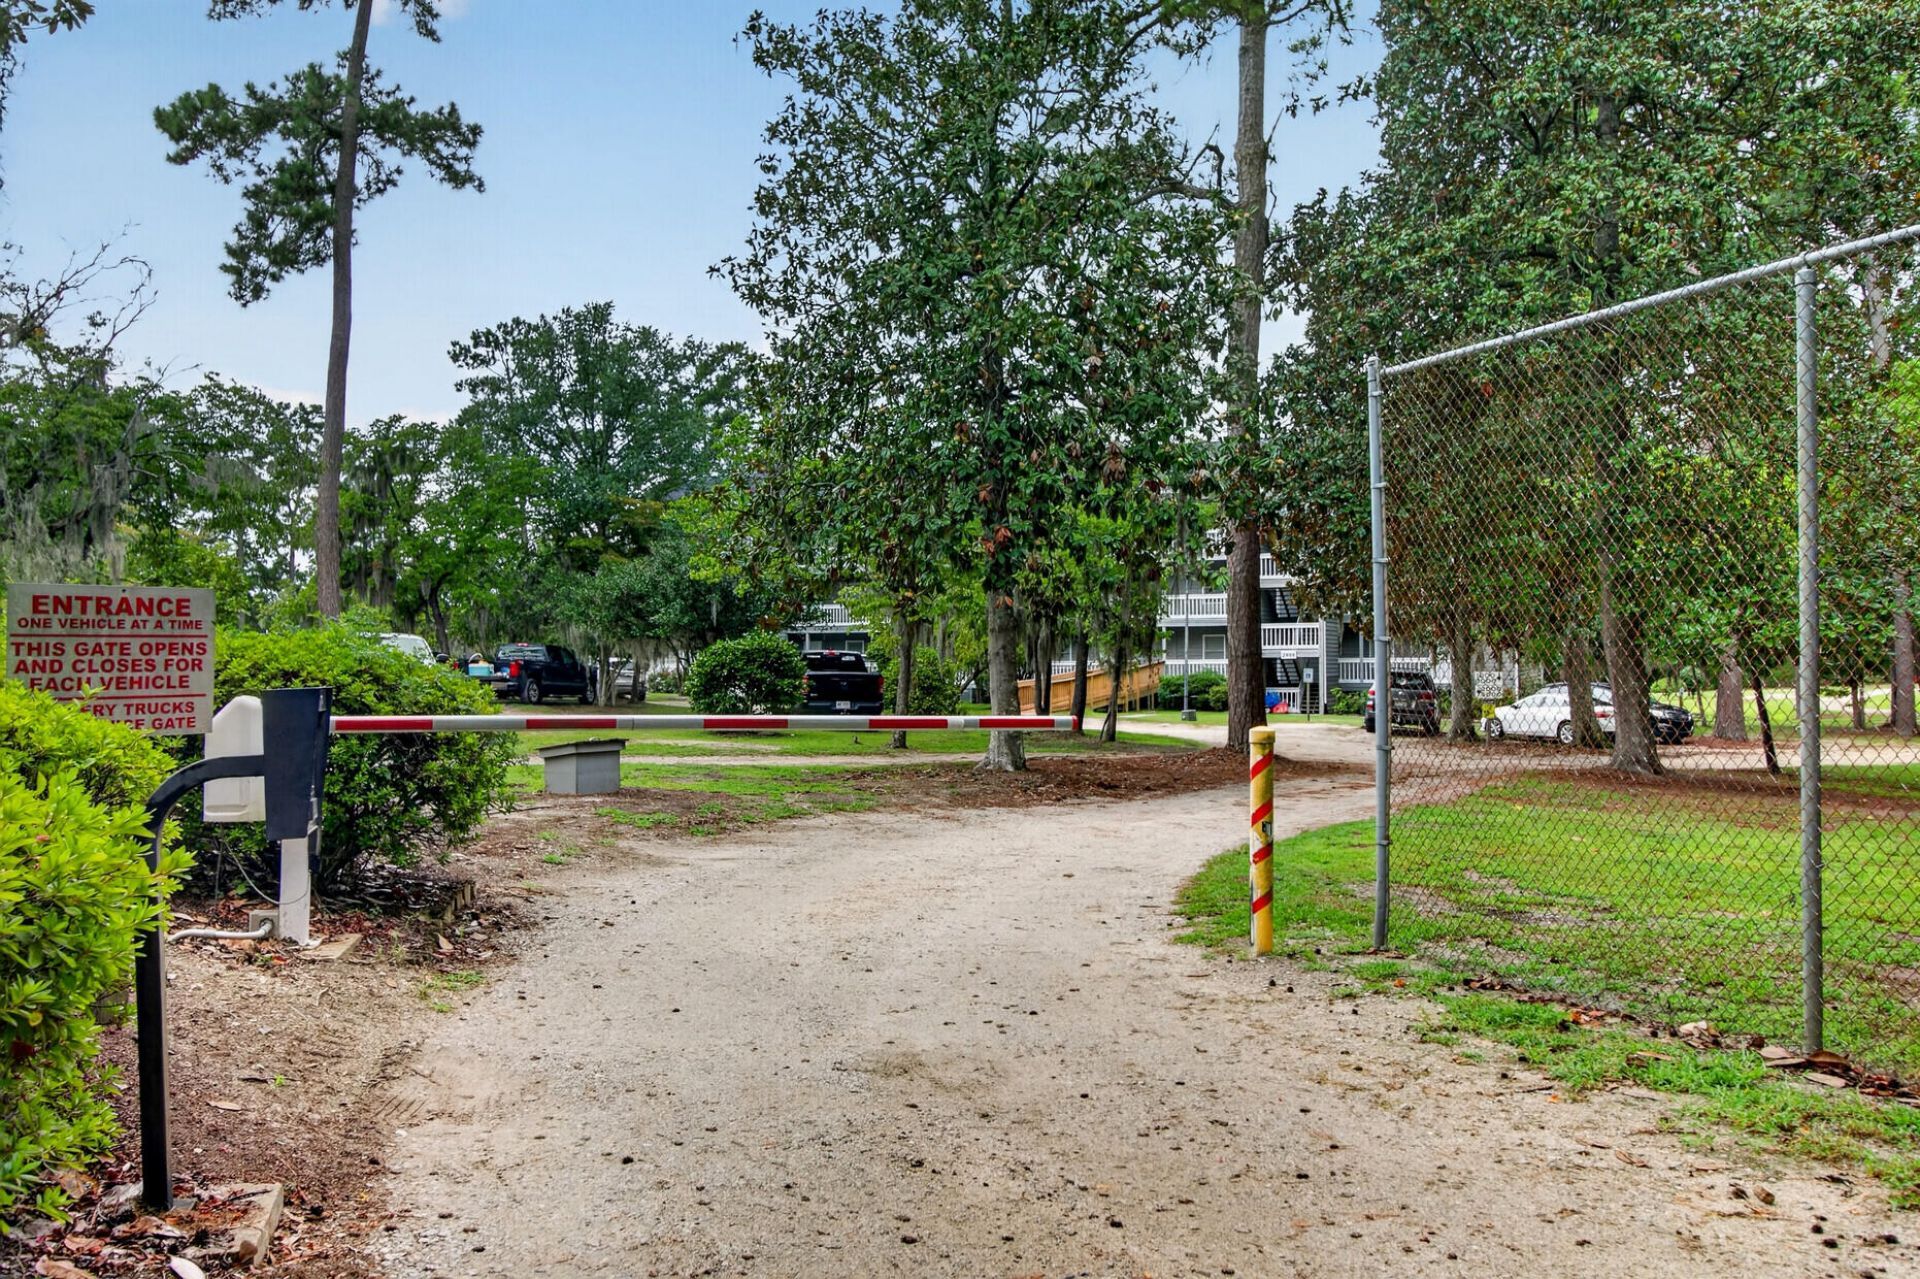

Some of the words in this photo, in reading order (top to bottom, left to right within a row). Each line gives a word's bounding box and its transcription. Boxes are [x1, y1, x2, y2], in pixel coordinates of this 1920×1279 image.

[32, 594, 191, 617] ENTRANCE
[17, 617, 52, 629] ONE
[58, 618, 126, 630] VEHICLE
[130, 619, 150, 630] AT
[153, 619, 164, 630] A
[169, 619, 203, 630] TIME
[10, 642, 66, 657] THIS
[74, 642, 131, 657] GATE
[139, 642, 207, 656] OPENS
[14, 659, 63, 674] AND
[72, 658, 156, 674] CLOSES
[164, 658, 204, 673] FOR
[29, 676, 92, 692] EACH
[100, 675, 190, 691] VEHICLE
[123, 701, 196, 716] TRUCKS
[152, 716, 196, 730] GATE
